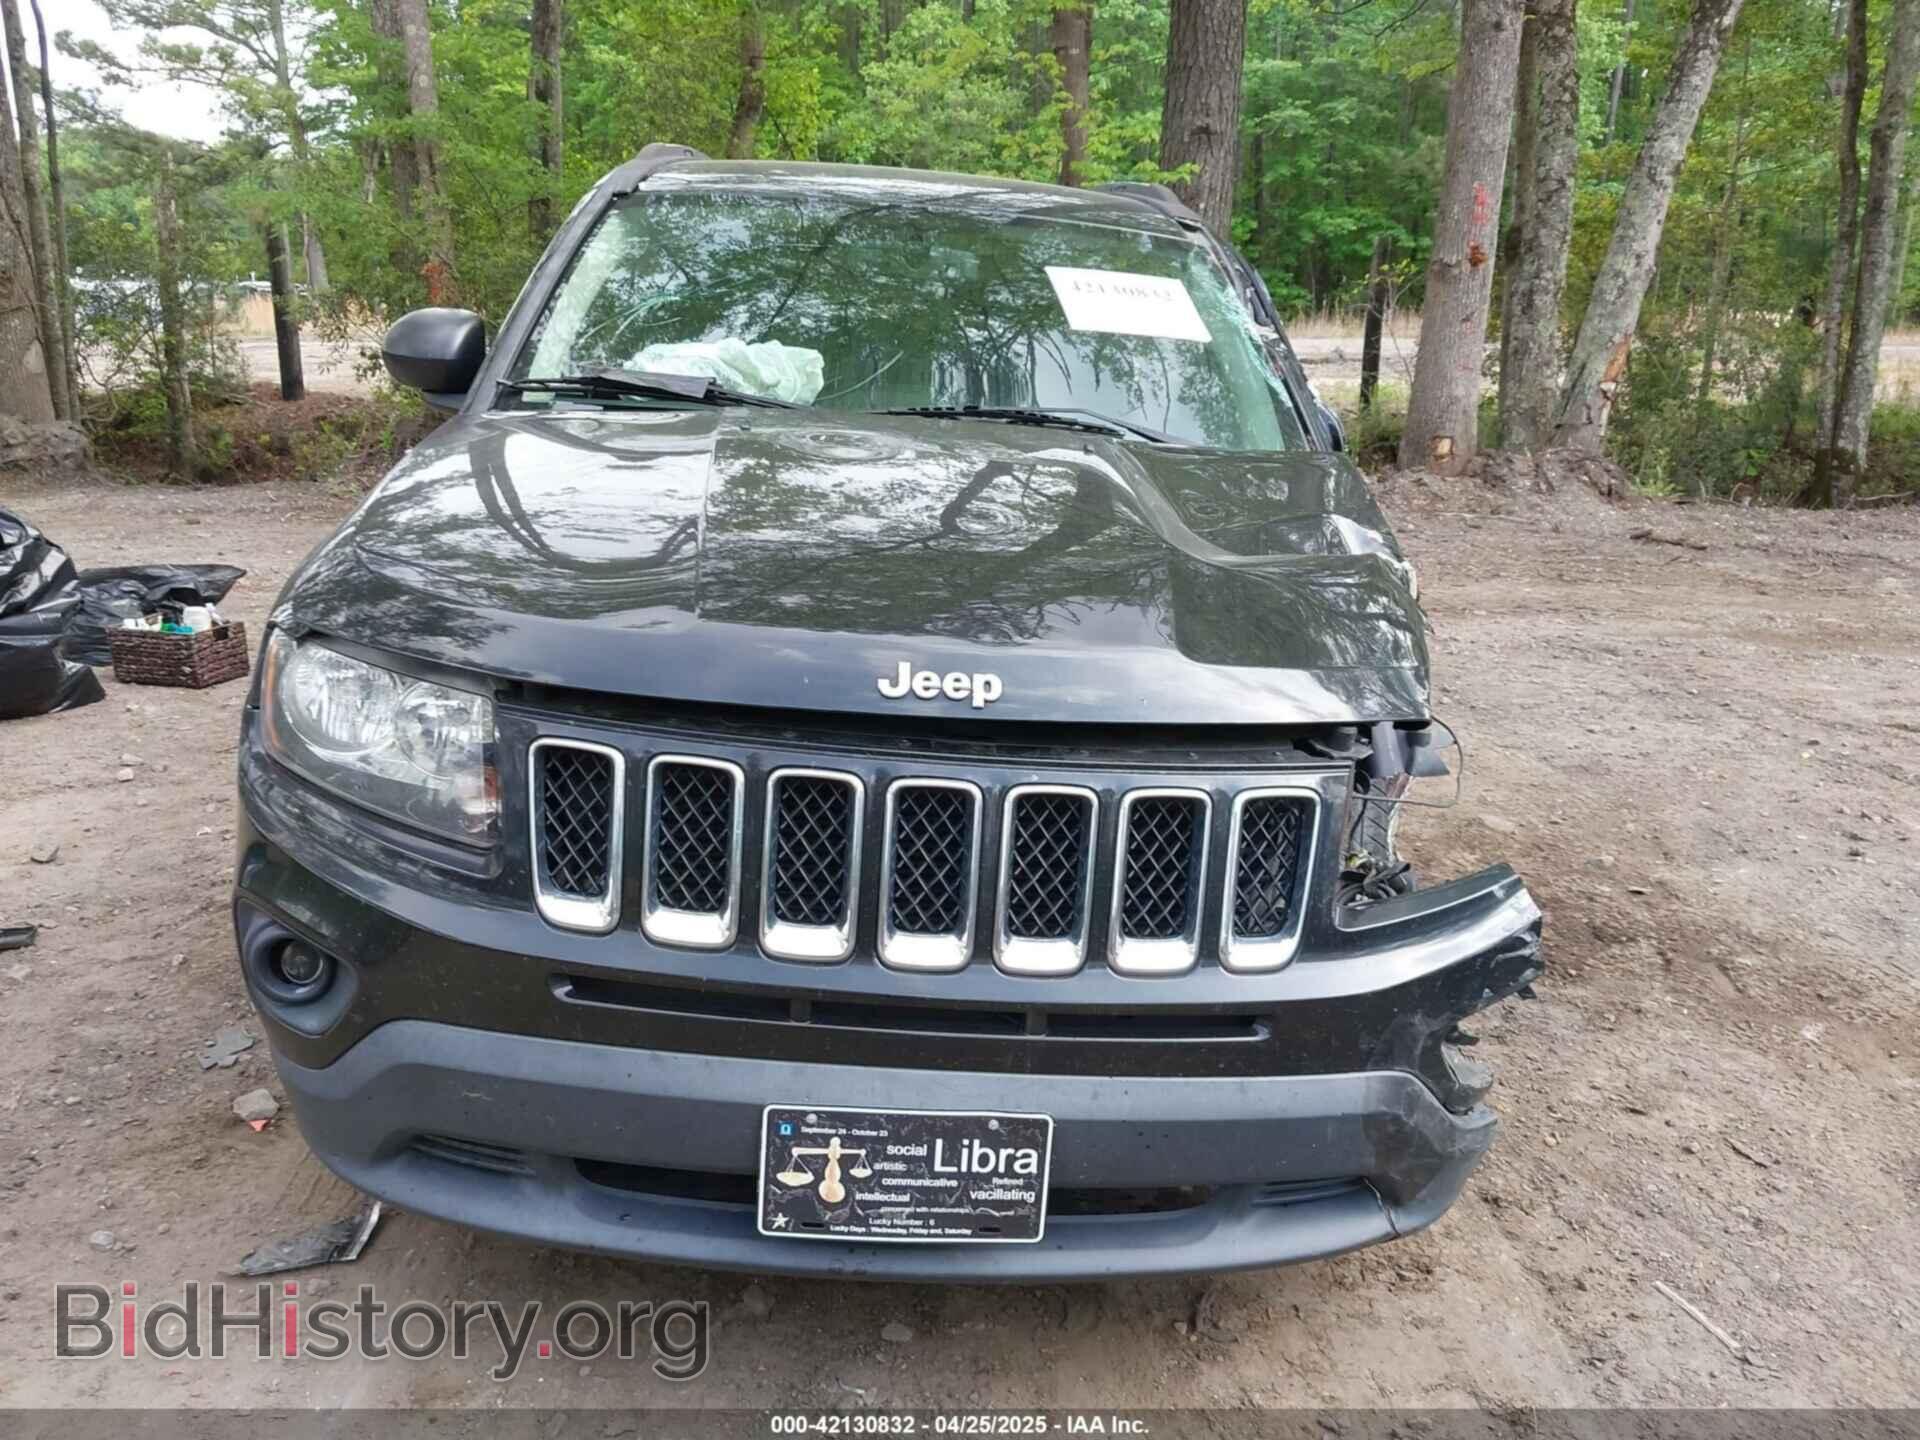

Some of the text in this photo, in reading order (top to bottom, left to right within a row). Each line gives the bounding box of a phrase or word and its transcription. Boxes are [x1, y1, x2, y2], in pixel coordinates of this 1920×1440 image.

[877, 661, 1002, 709] Jeep
[886, 1144, 928, 1157] social
[934, 1138, 1039, 1175] Libra
[873, 1161, 908, 1171] artistic
[881, 1177, 958, 1187] communicative
[856, 1191, 910, 1202] intellectual
[969, 1188, 1035, 1203] vacillating
[869, 1217, 892, 1226] Lucky
